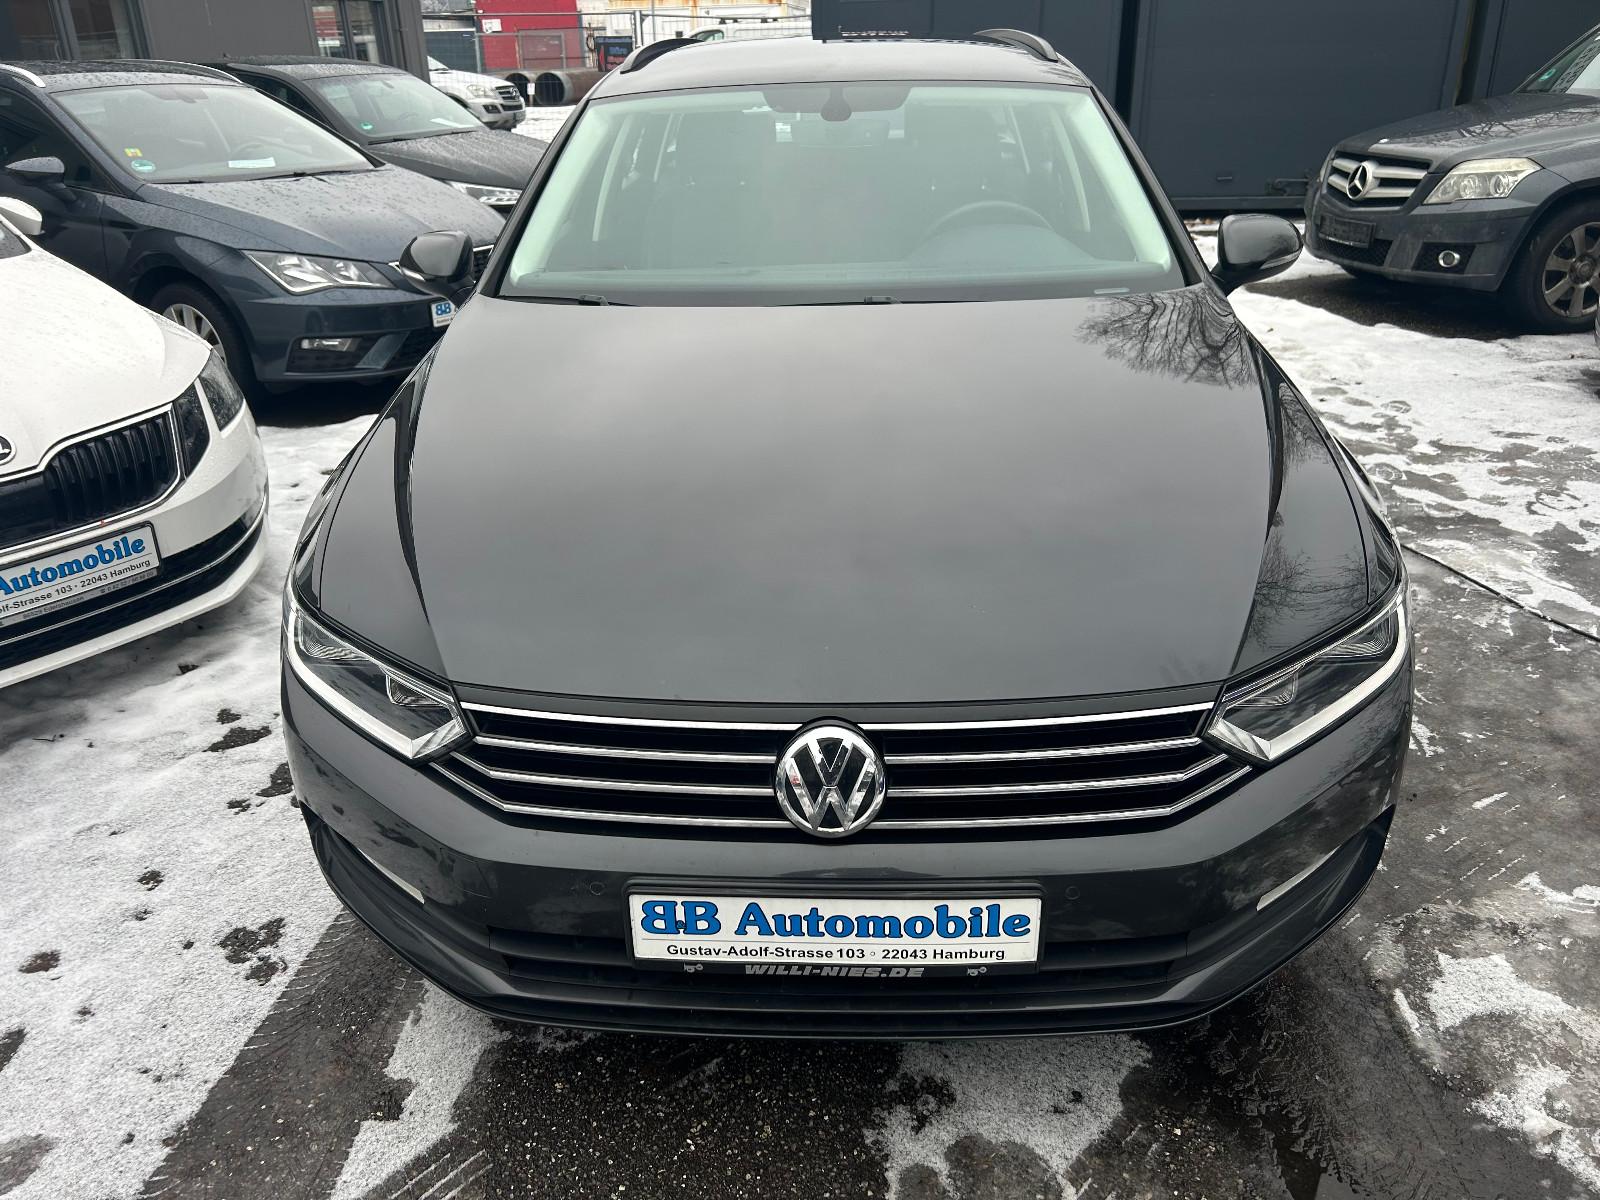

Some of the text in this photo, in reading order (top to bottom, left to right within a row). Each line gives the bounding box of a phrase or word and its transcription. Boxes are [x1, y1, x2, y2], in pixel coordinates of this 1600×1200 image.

[55, 584, 73, 596] 103
[81, 573, 108, 588] 22043
[110, 560, 151, 578] Hamburg
[734, 902, 1031, 939] Automobile
[666, 944, 1006, 960] Gustav-Adolf-Strasse 103 22043 Hamburg
[744, 964, 925, 978] WILLI-NIES.DE
